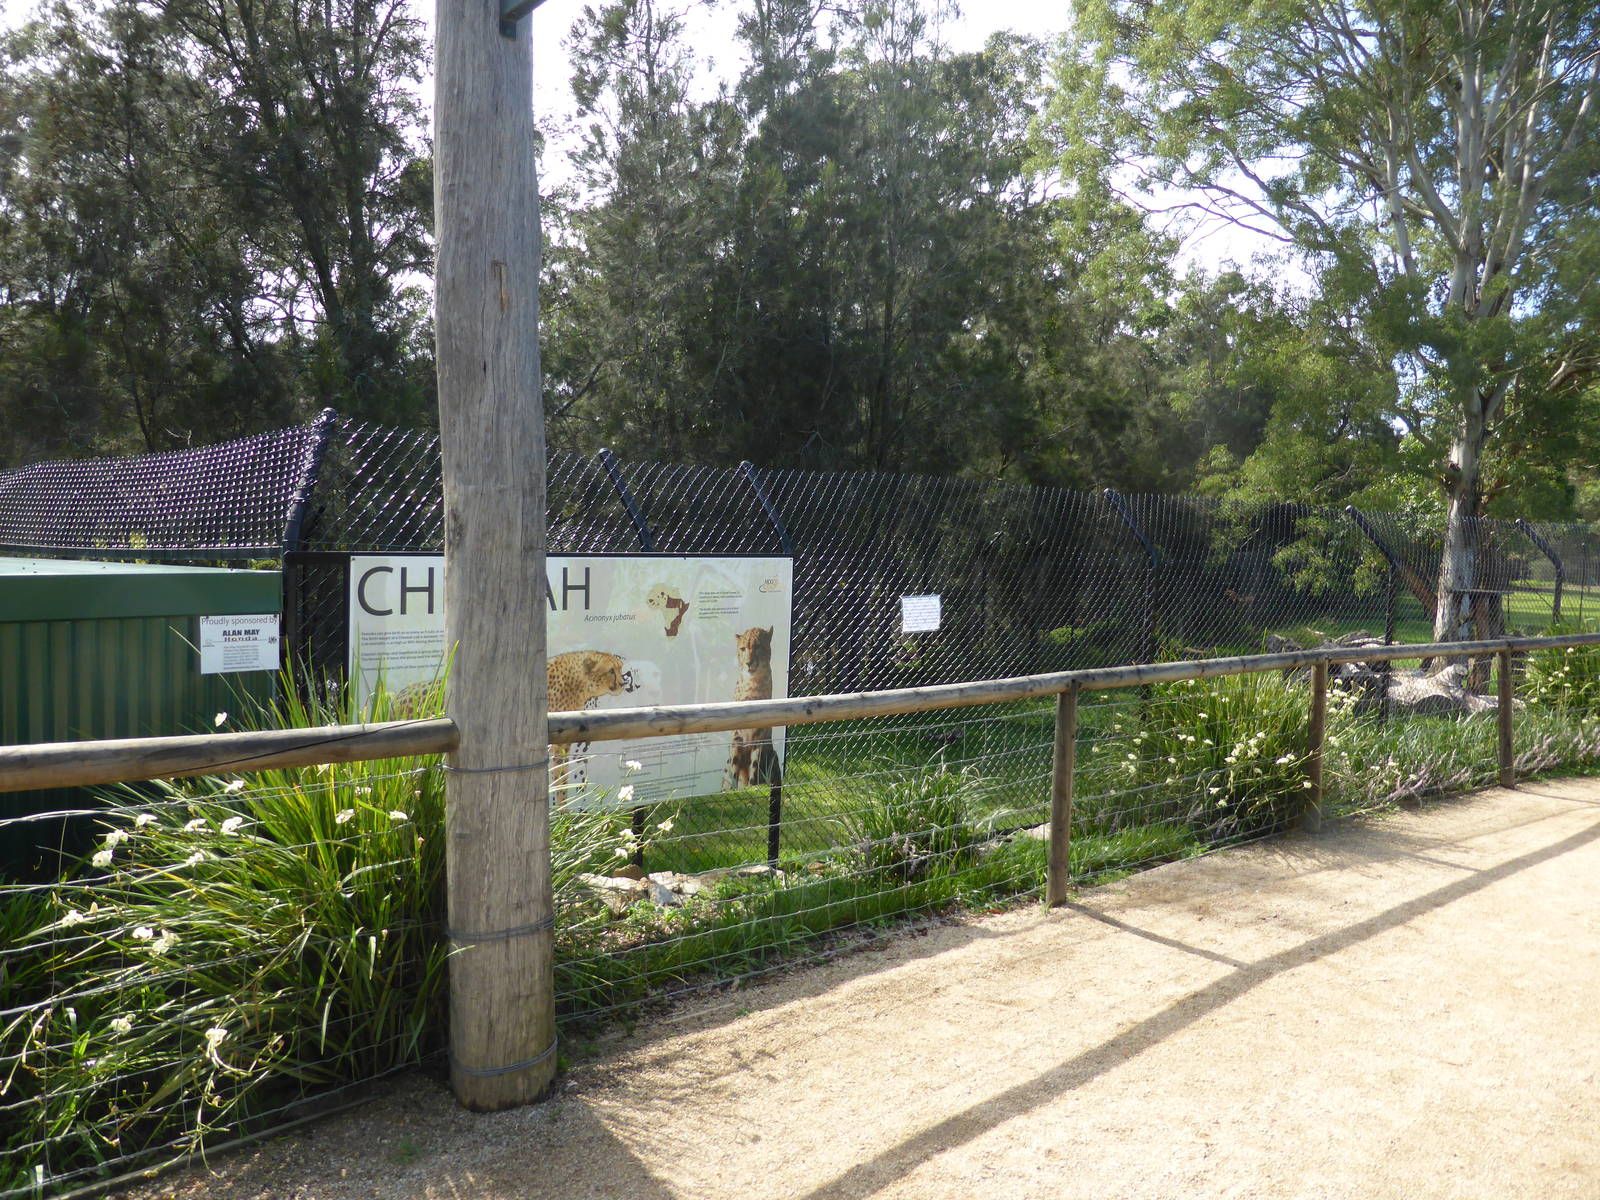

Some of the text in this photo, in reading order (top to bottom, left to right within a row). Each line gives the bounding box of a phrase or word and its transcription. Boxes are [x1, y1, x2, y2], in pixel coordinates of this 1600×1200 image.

[201, 615, 278, 627] Proudly sponsored by
[222, 629, 242, 637] ALAN
